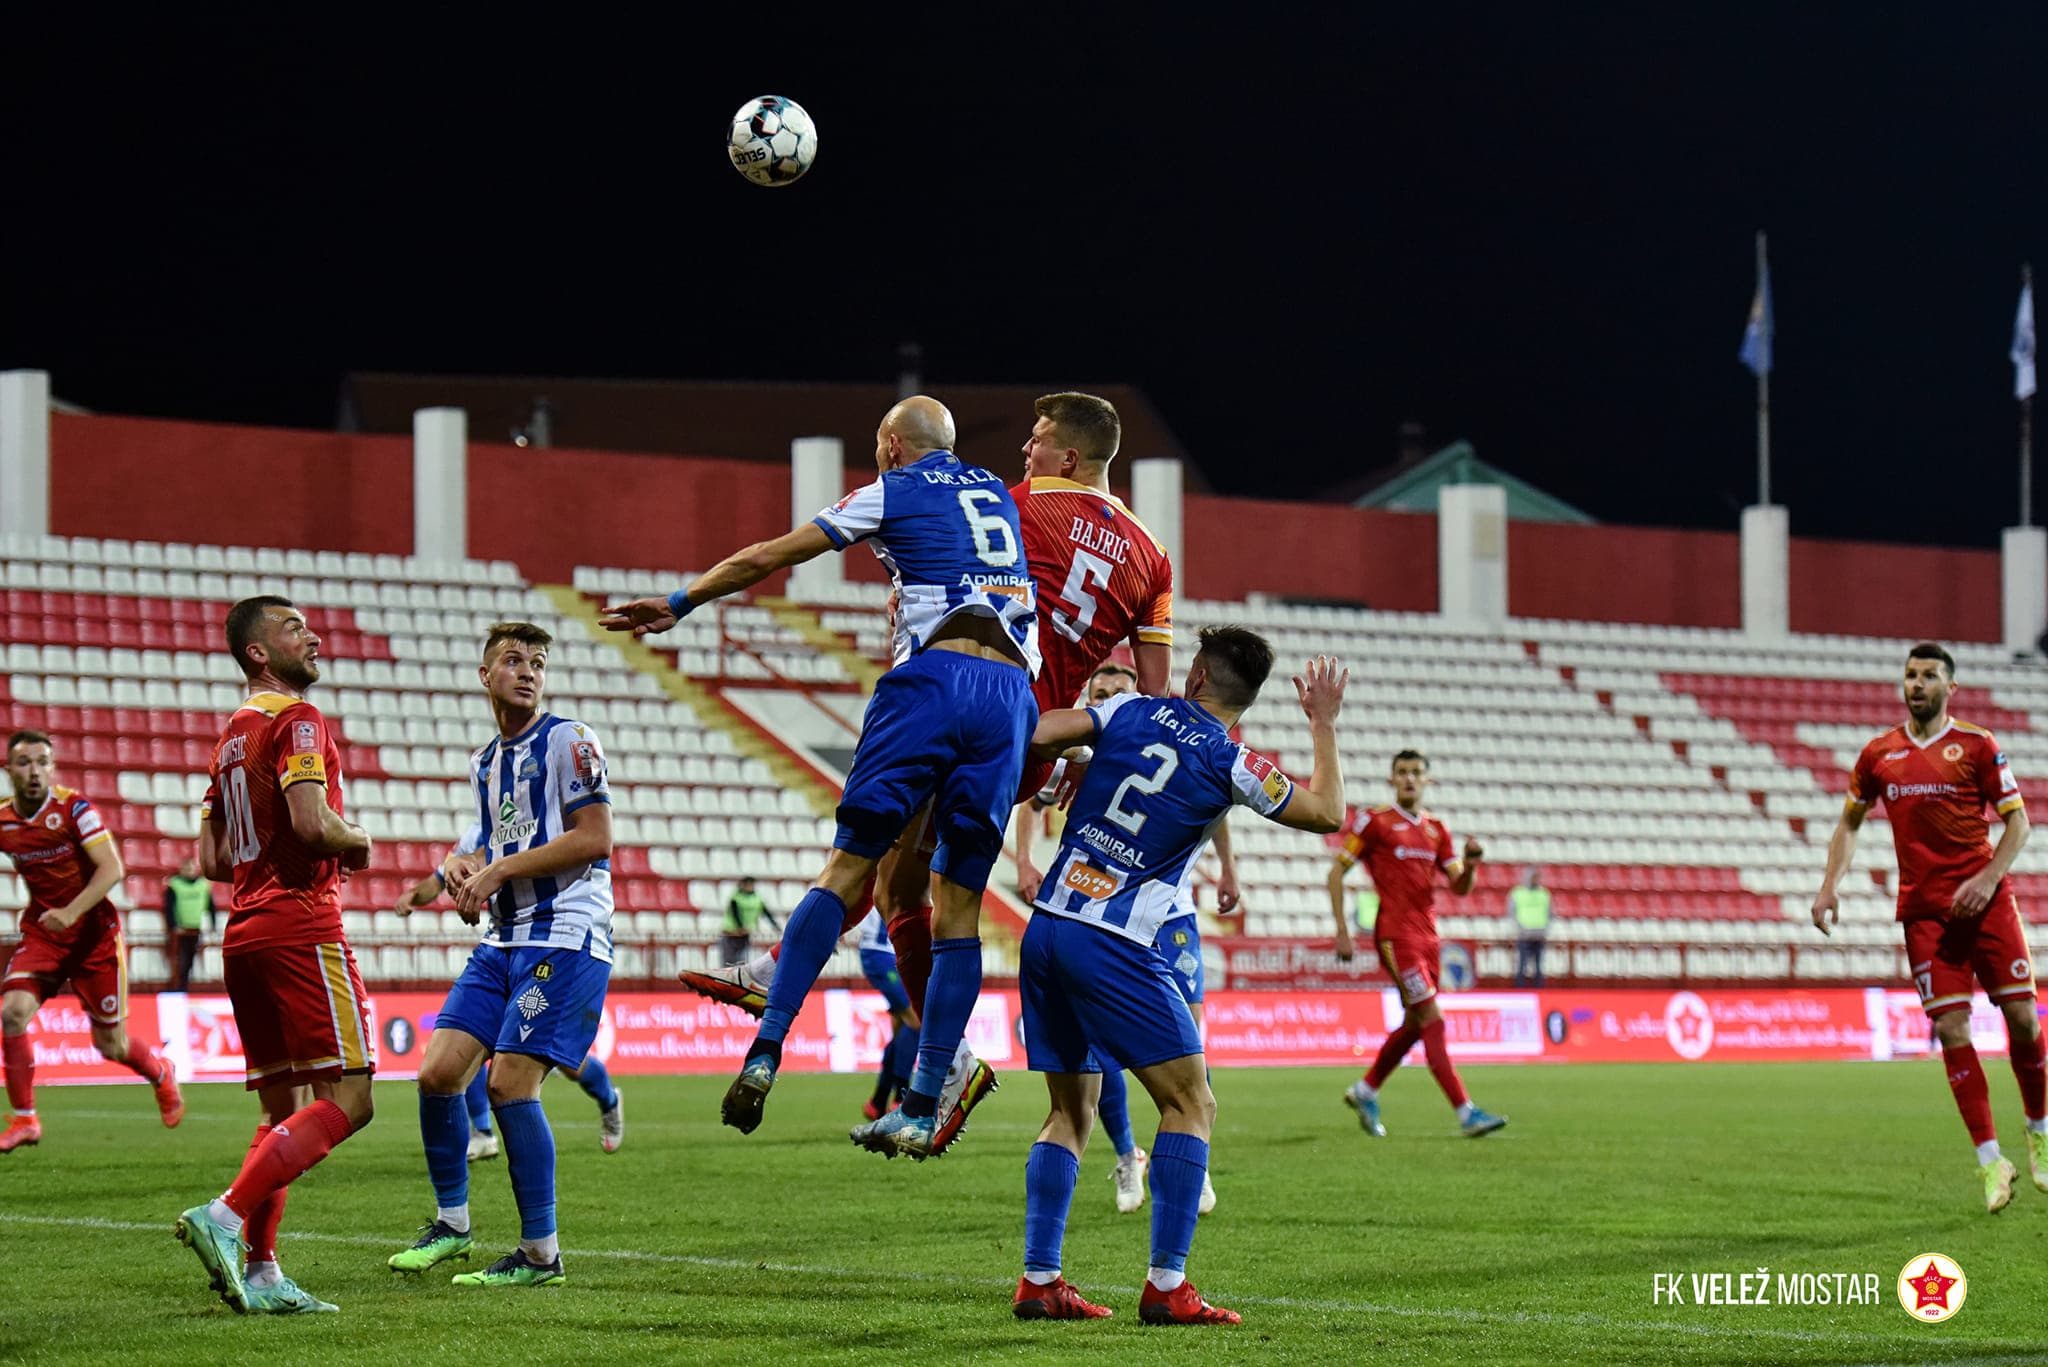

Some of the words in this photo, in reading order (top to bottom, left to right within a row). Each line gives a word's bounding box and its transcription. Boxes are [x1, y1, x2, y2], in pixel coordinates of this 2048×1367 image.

[957, 489, 1018, 567] 6
[1068, 516, 1131, 565] BAJRIĆ
[1051, 548, 1114, 643] 5
[219, 765, 262, 867] 10
[1103, 742, 1179, 836] 2
[1069, 868, 1091, 888] bh
[1077, 823, 1146, 869] ADMIRAL
